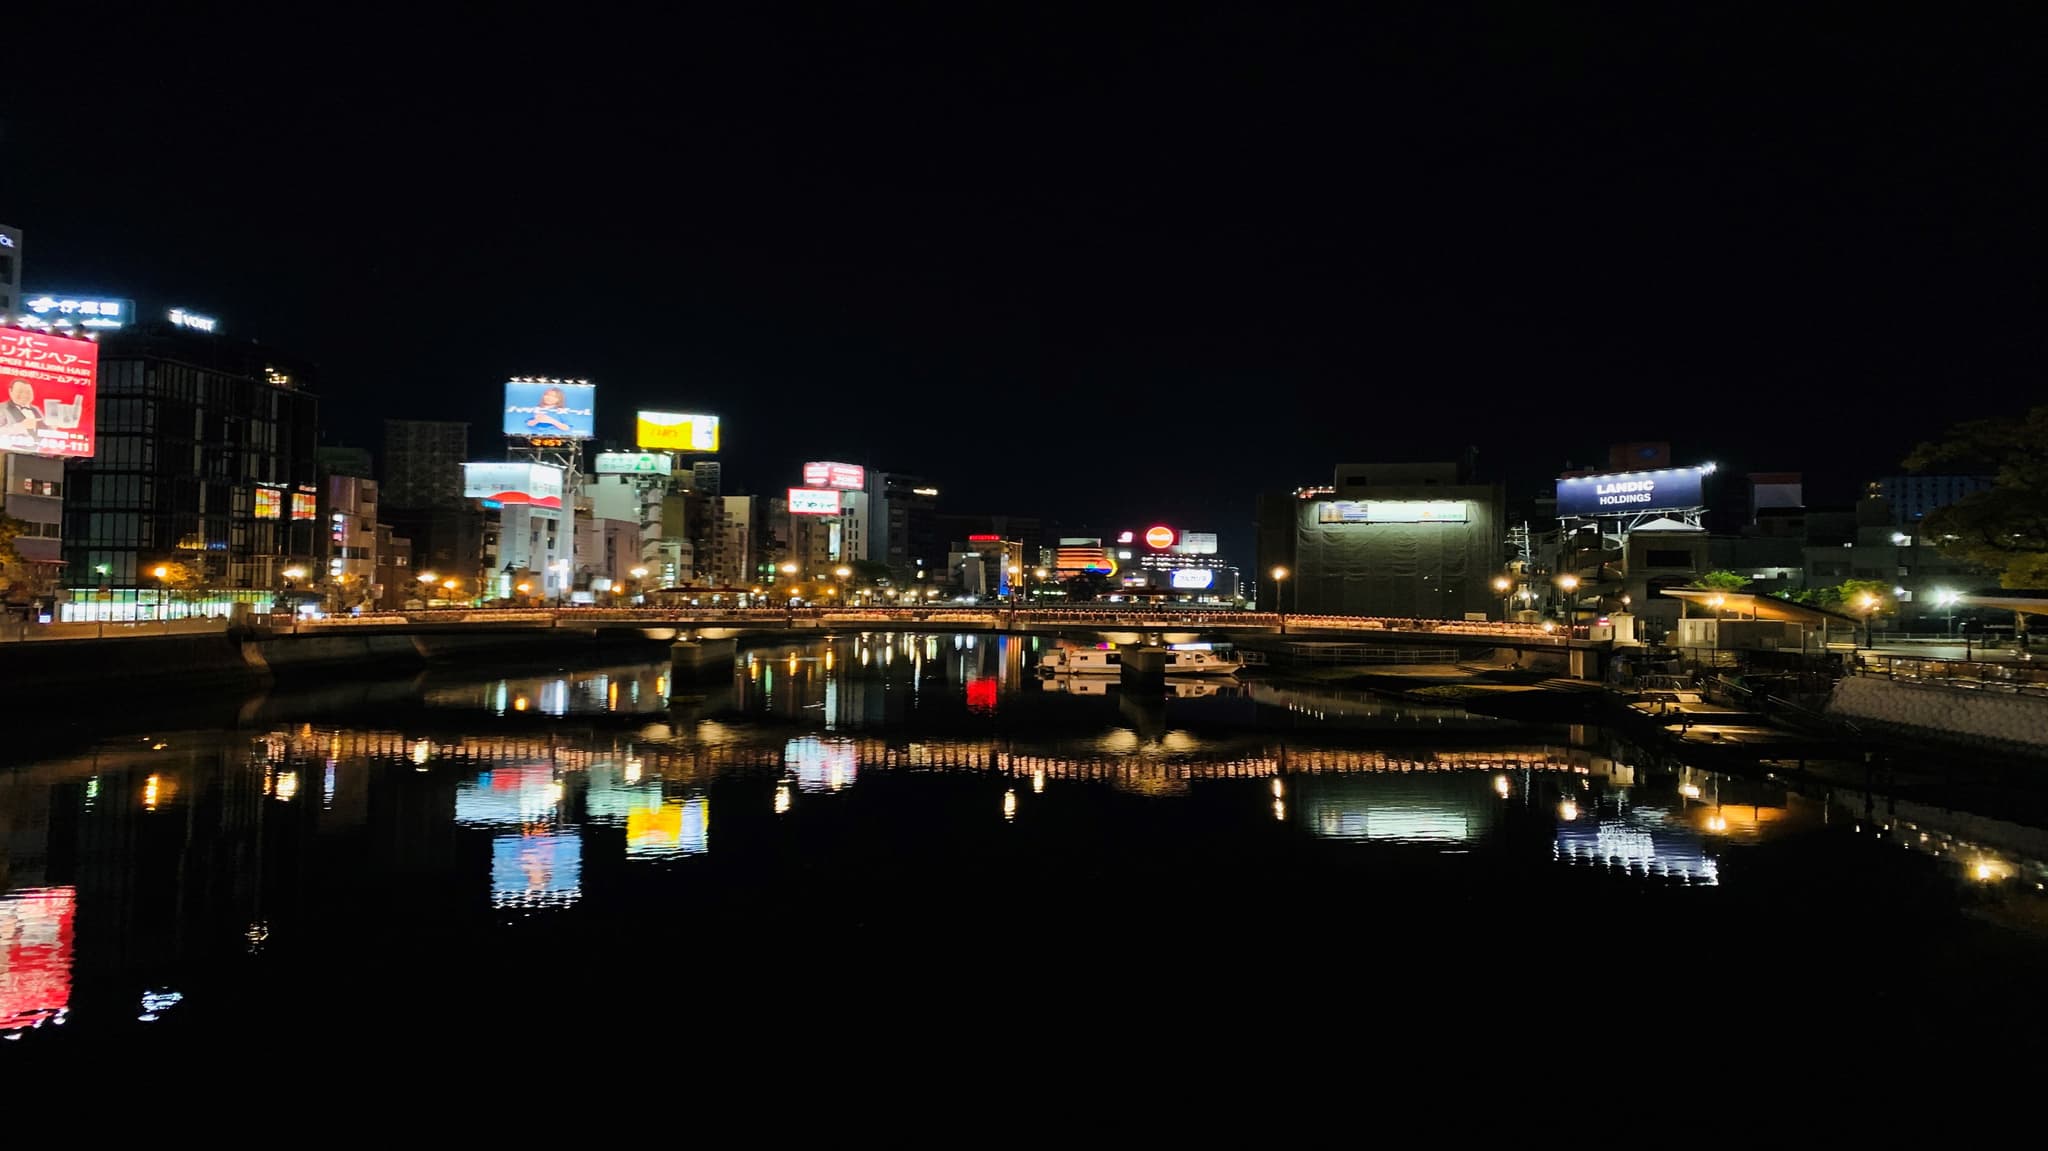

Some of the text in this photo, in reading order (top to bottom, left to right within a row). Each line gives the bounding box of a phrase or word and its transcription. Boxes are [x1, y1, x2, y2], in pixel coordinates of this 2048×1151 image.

[1, 344, 91, 364] リオンヘアー
[25, 360, 65, 371] MILLION
[66, 366, 91, 377] HAIR
[1597, 480, 1654, 495] LANDIC
[1600, 493, 1651, 505] HOLDINGS
